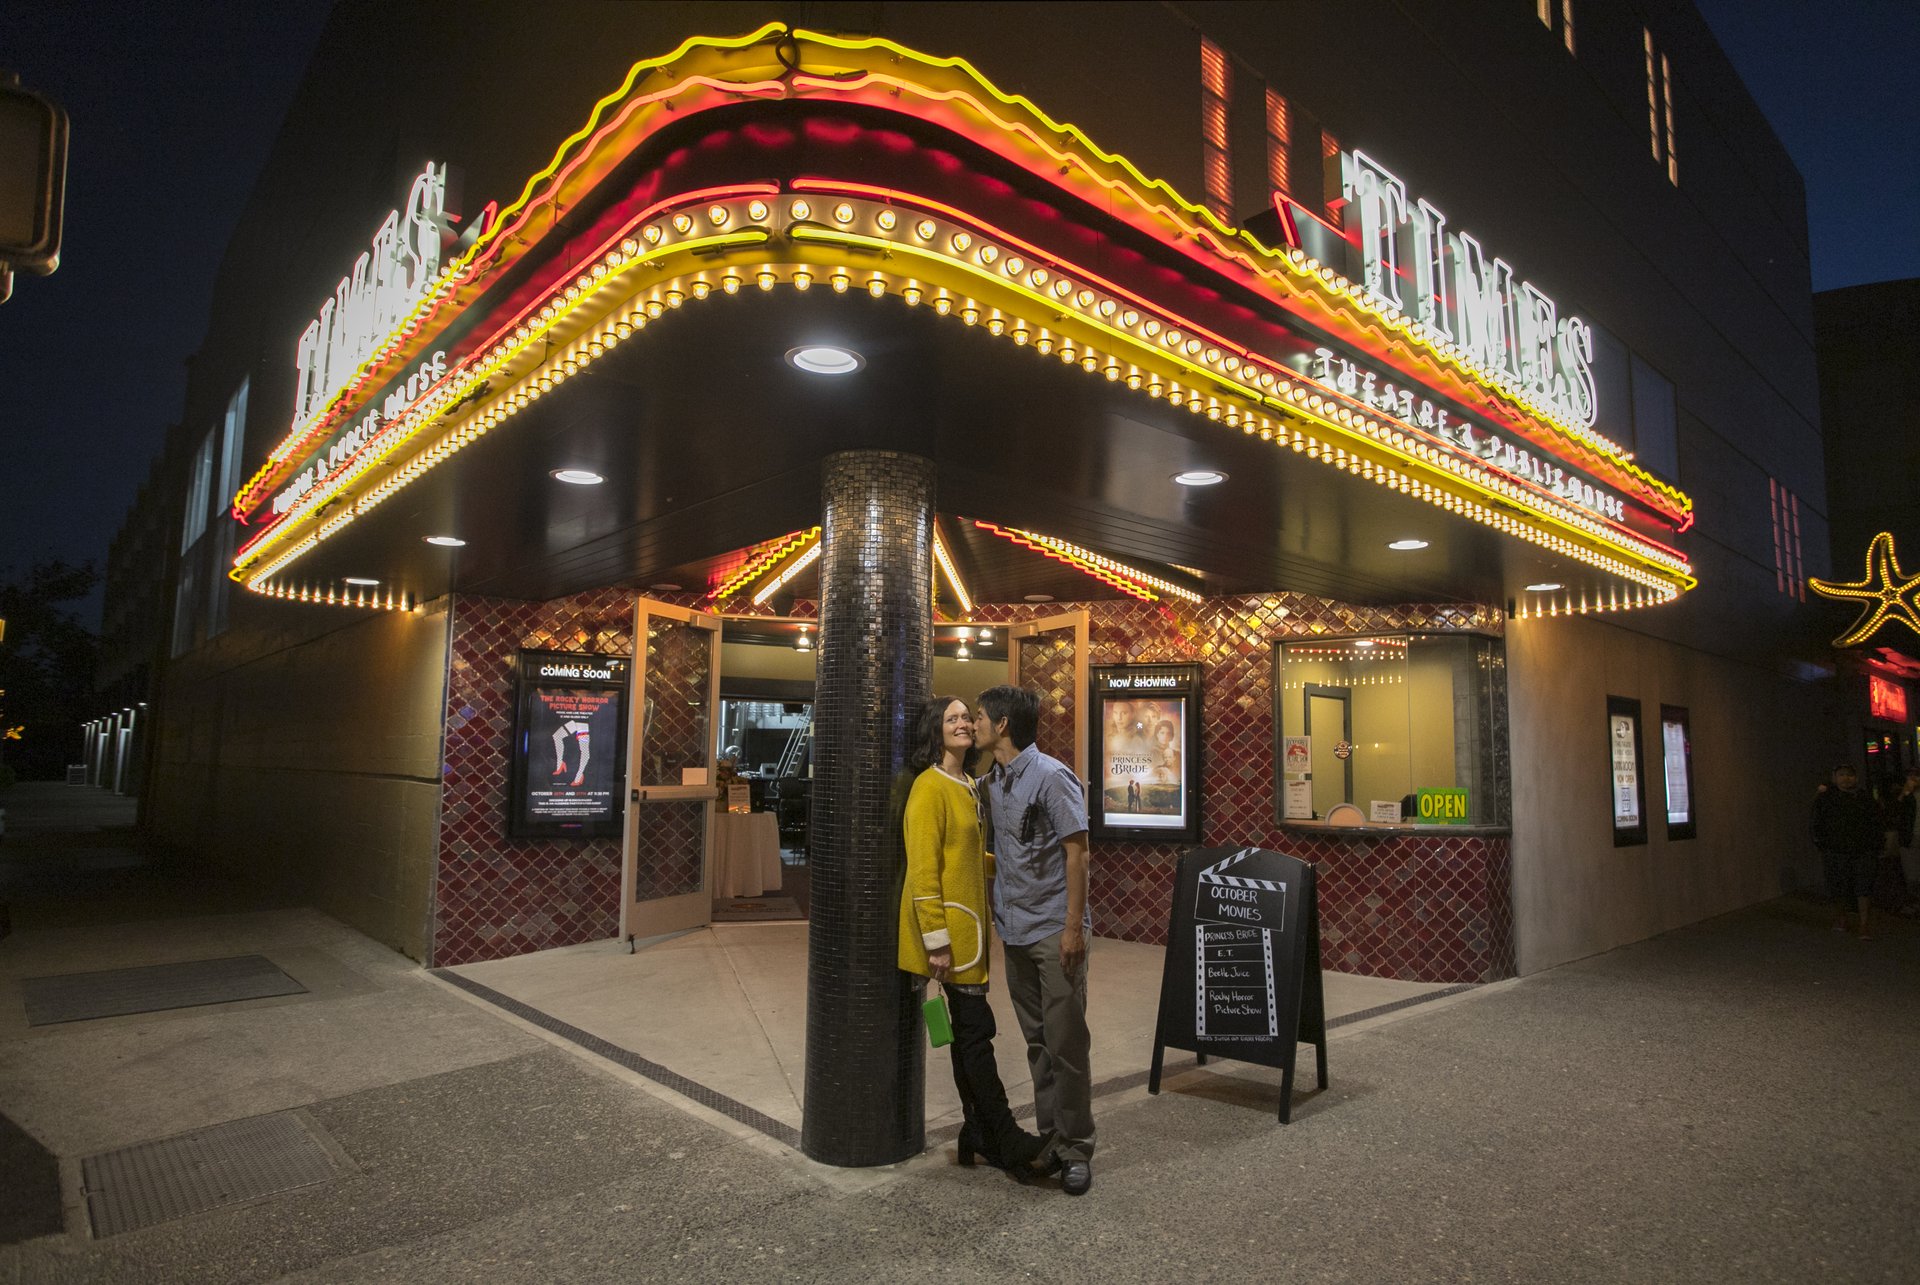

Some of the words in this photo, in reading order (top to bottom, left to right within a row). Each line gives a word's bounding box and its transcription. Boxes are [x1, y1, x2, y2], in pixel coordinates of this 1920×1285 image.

[1350, 149, 1598, 428] TIMES
[1314, 348, 1449, 437] THEATRE
[1490, 435, 1565, 493] PUBLIC
[1566, 476, 1625, 522] HOUSE
[540, 666, 580, 678] COMING
[583, 669, 611, 680] SOON
[1109, 678, 1131, 688] NOW
[1134, 678, 1176, 688] SHOWING
[540, 695, 554, 703] THE
[555, 696, 580, 704] ROCKY
[581, 697, 609, 705] HORROR
[548, 703, 577, 711] PICTURE
[578, 704, 600, 712] SHOW
[1112, 756, 1152, 765] PRINCESS
[1111, 763, 1149, 776] BRIDE
[1420, 793, 1466, 818] OPEN
[1211, 886, 1258, 903] OCTOBER
[1218, 904, 1262, 922] MOVIES
[1205, 931, 1235, 942] PRINCESS
[1236, 929, 1258, 940] BRIDE
[1214, 1004, 1241, 1015] Picture
[1241, 1004, 1262, 1015] Show
